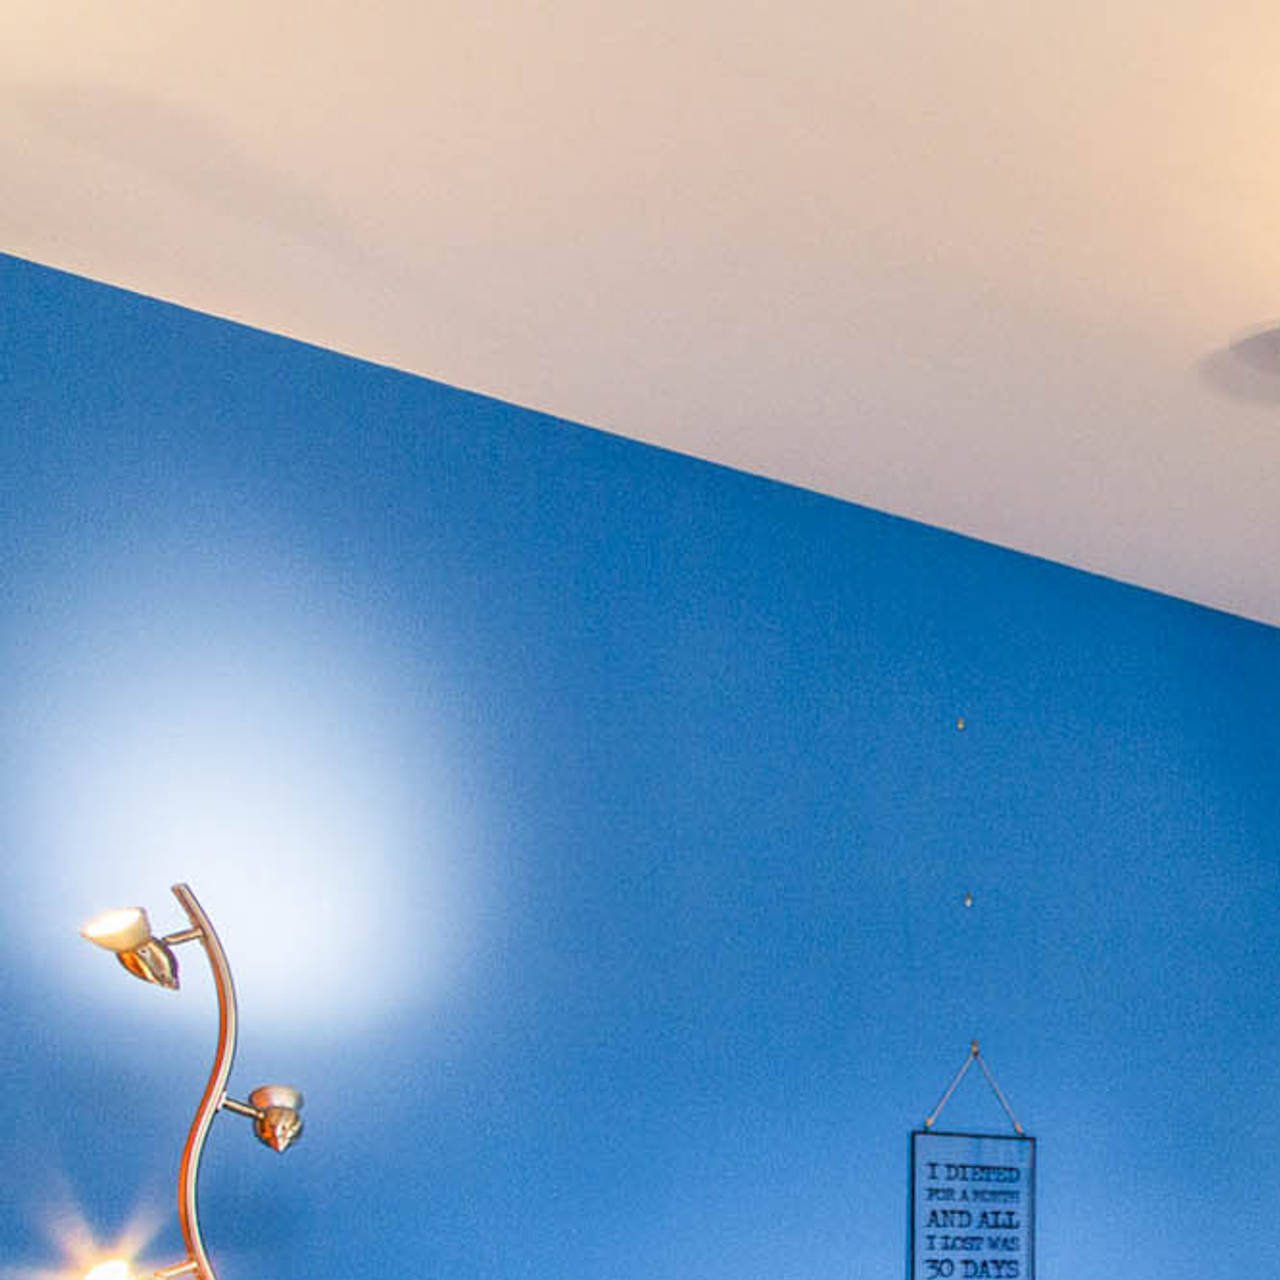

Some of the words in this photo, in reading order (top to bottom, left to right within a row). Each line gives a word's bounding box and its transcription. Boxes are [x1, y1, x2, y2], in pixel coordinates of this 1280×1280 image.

[926, 1163, 937, 1181] I
[941, 1164, 1021, 1184] DIETED
[927, 1188, 955, 1202] FOR
[959, 1189, 969, 1202] A
[972, 1190, 1021, 1203] MONTH
[926, 1210, 971, 1229] AND
[976, 1211, 1021, 1229] ALL
[926, 1235, 937, 1251] I
[940, 1236, 984, 1251] LOST
[987, 1237, 1021, 1251] WAS
[924, 1259, 955, 1280] 30
[963, 1260, 1020, 1280] DAYS
